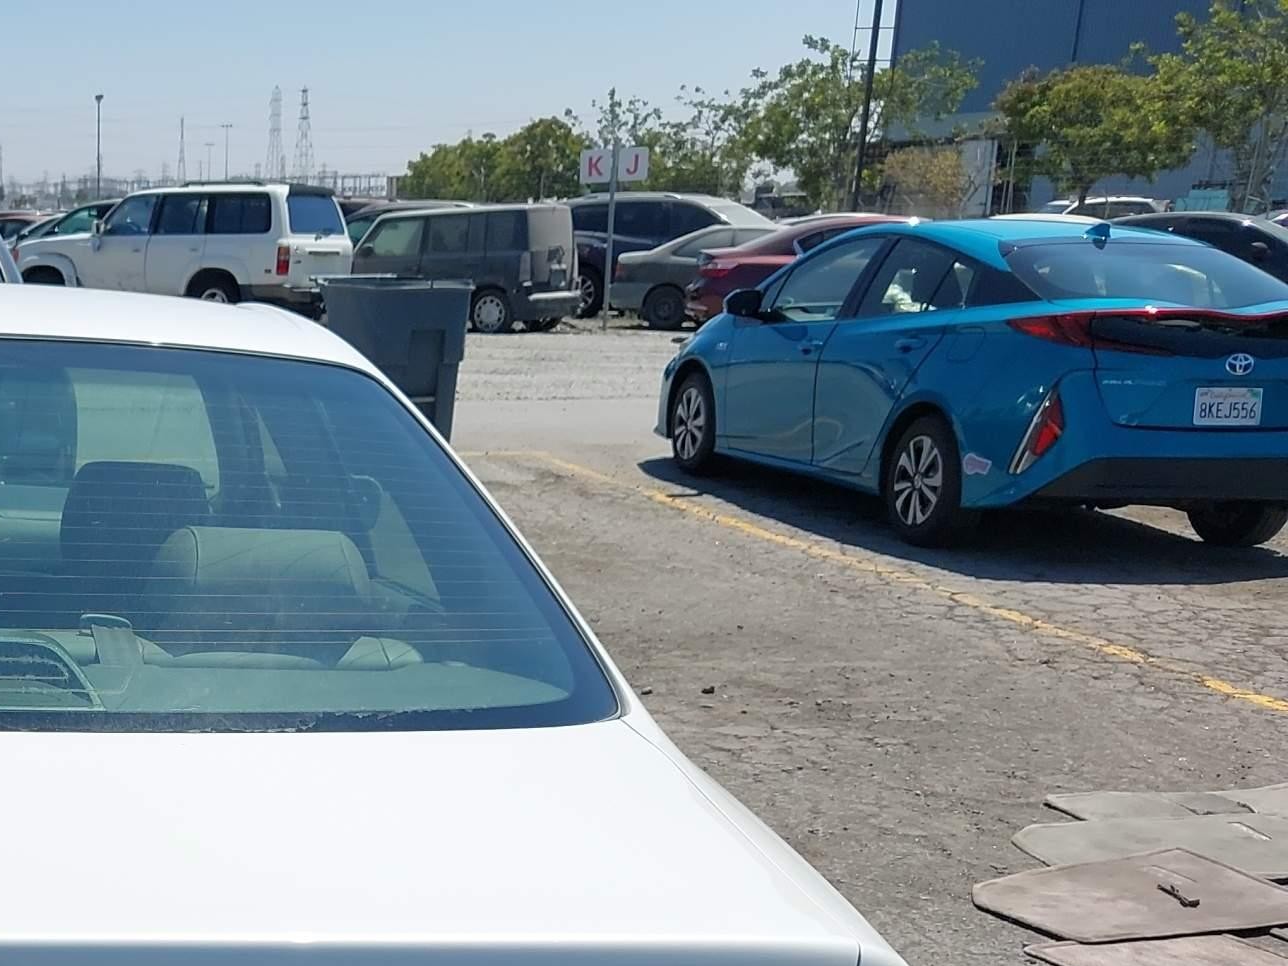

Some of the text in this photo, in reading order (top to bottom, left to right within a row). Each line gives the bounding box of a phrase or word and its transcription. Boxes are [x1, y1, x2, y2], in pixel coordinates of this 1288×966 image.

[588, 155, 603, 176] K
[626, 153, 639, 175] J
[1199, 401, 1257, 419] 8KEJ556
